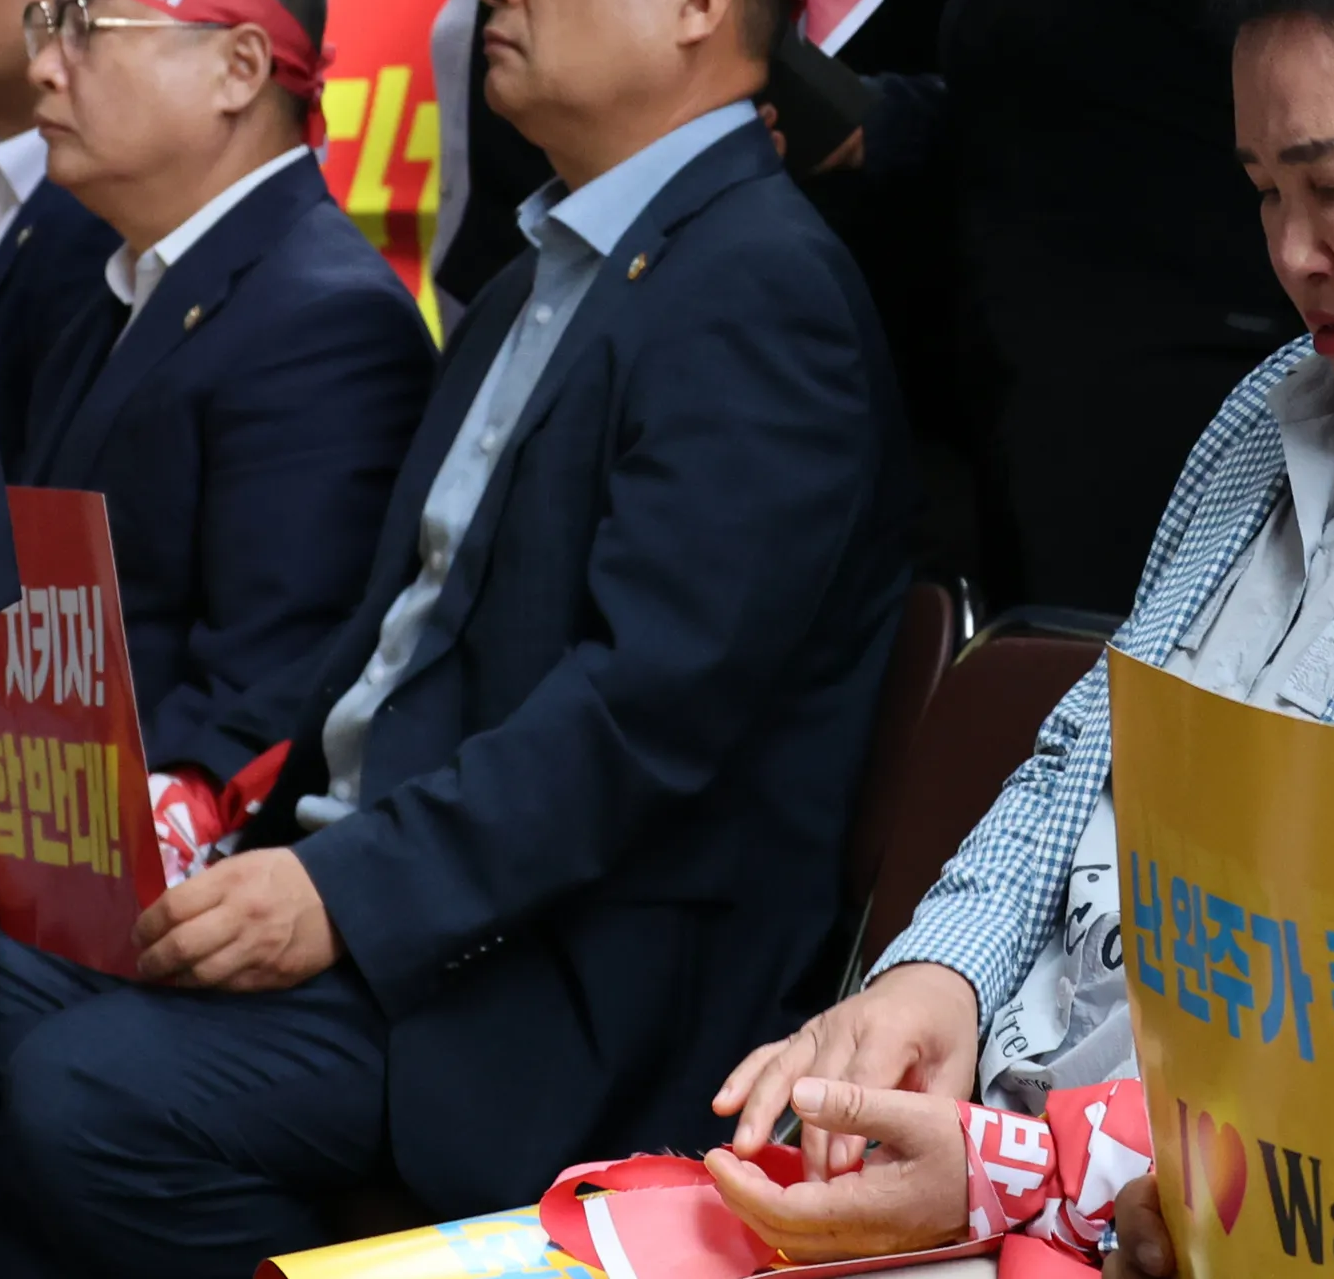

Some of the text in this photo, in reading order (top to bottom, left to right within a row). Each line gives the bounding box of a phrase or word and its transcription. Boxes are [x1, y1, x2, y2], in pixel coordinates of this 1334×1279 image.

[0, 584, 105, 708] 지키자!
[1129, 850, 1165, 997] 난
[1170, 875, 1315, 1063] 완주가
[1176, 1097, 1195, 1211] I
